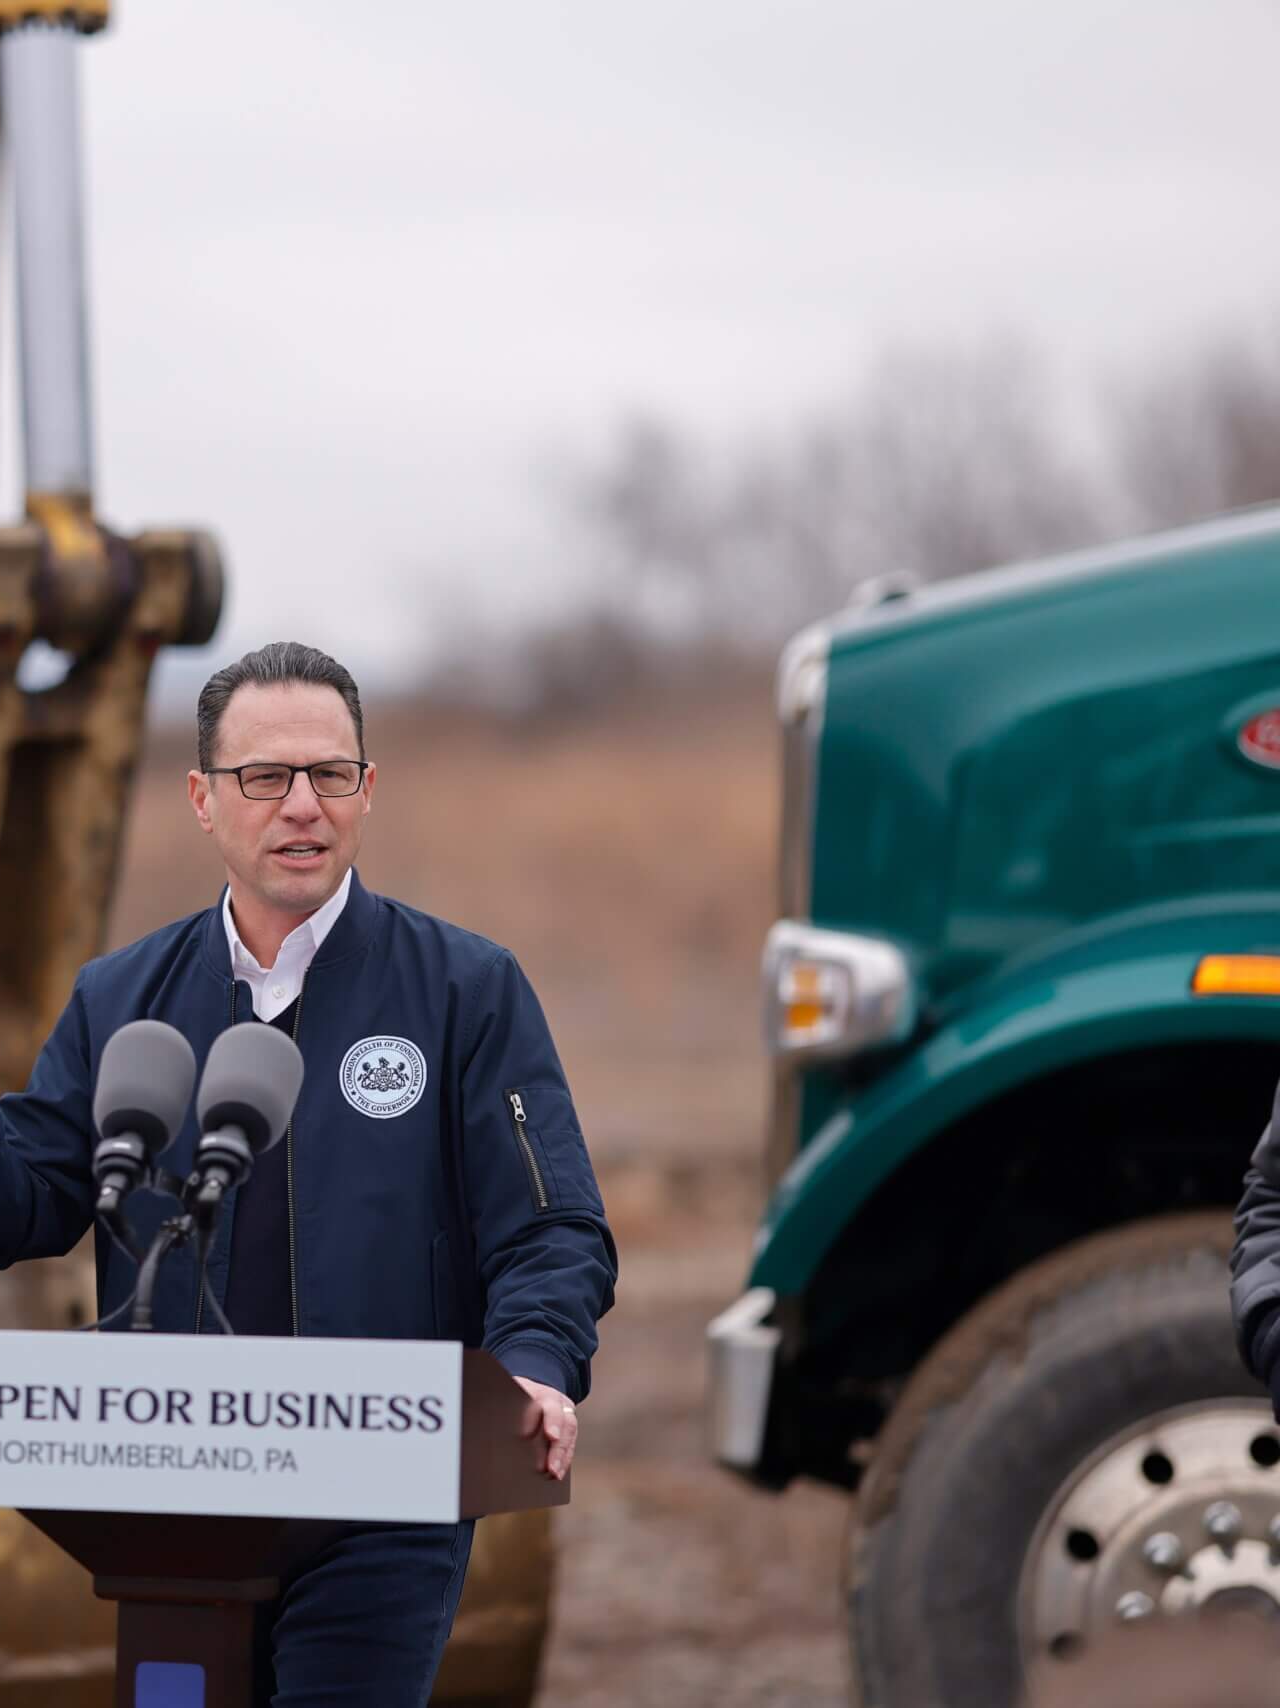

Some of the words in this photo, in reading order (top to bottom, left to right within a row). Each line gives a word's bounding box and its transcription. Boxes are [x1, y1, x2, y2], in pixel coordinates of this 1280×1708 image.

[345, 1041, 382, 1089] COMMONWEALTH
[395, 1043, 422, 1087] PENNSYLVANIA
[356, 1096, 369, 1108] THE
[371, 1096, 411, 1112] GOVERNOR
[98, 1387, 194, 1425] FOR
[209, 1390, 444, 1434] BUSINESS
[264, 1448, 299, 1473] PA
